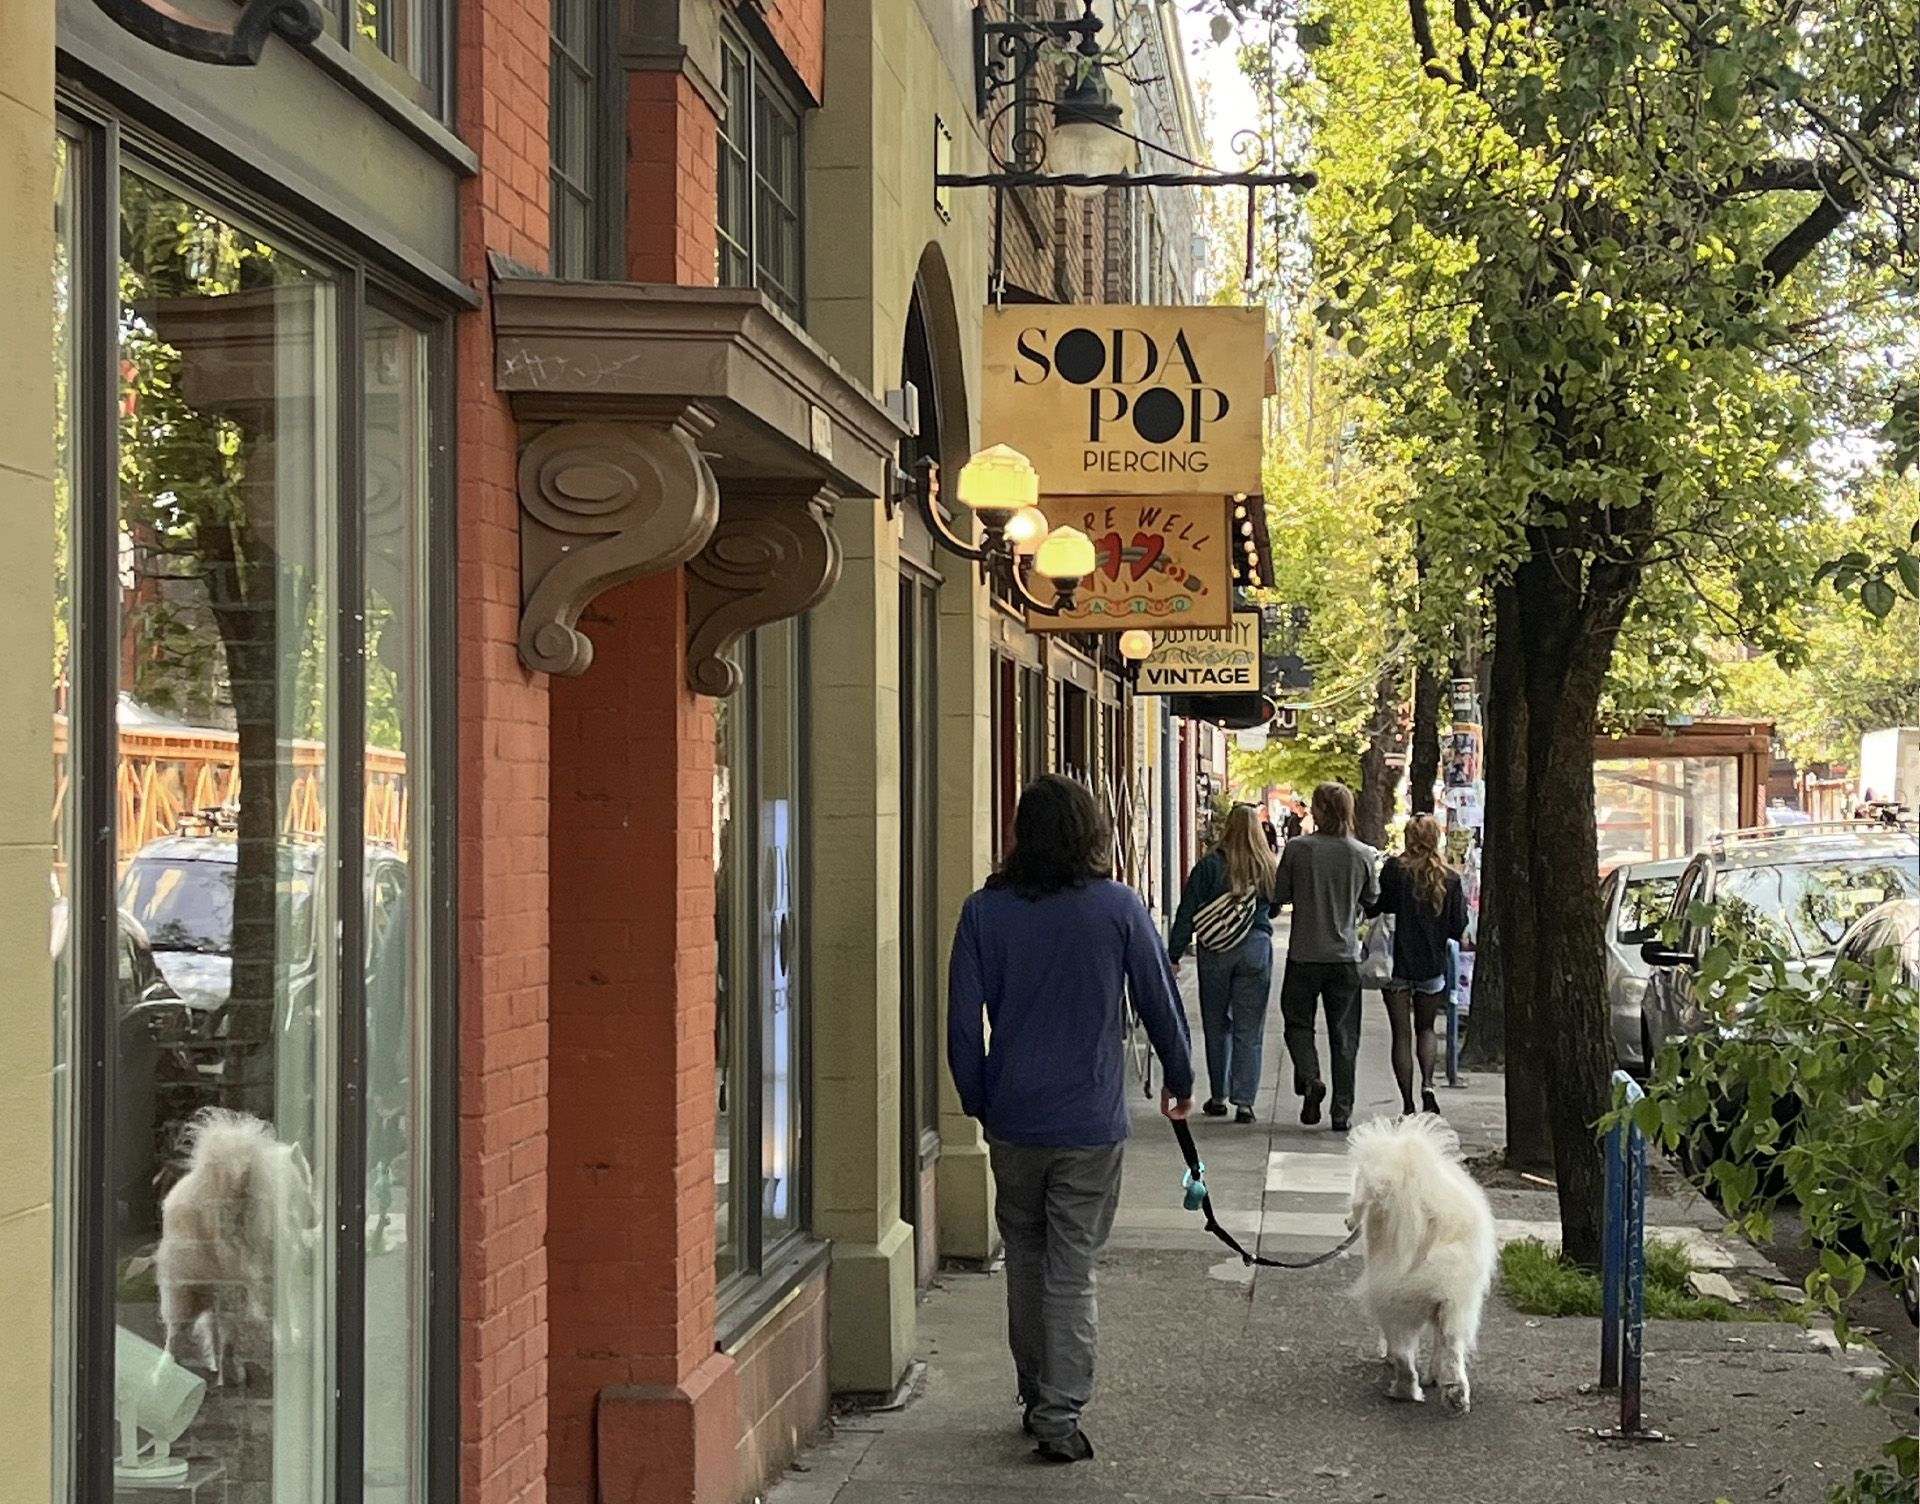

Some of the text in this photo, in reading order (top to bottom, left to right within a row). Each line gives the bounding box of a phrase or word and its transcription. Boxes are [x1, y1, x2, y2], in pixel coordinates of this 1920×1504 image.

[1014, 327, 1206, 385] SODA
[1083, 387, 1229, 444] POP
[1083, 450, 1209, 473] PIERCING
[1138, 506, 1210, 551] WELL
[1091, 599, 1187, 614] ATTOO
[1147, 668, 1250, 685] VINTAGE
